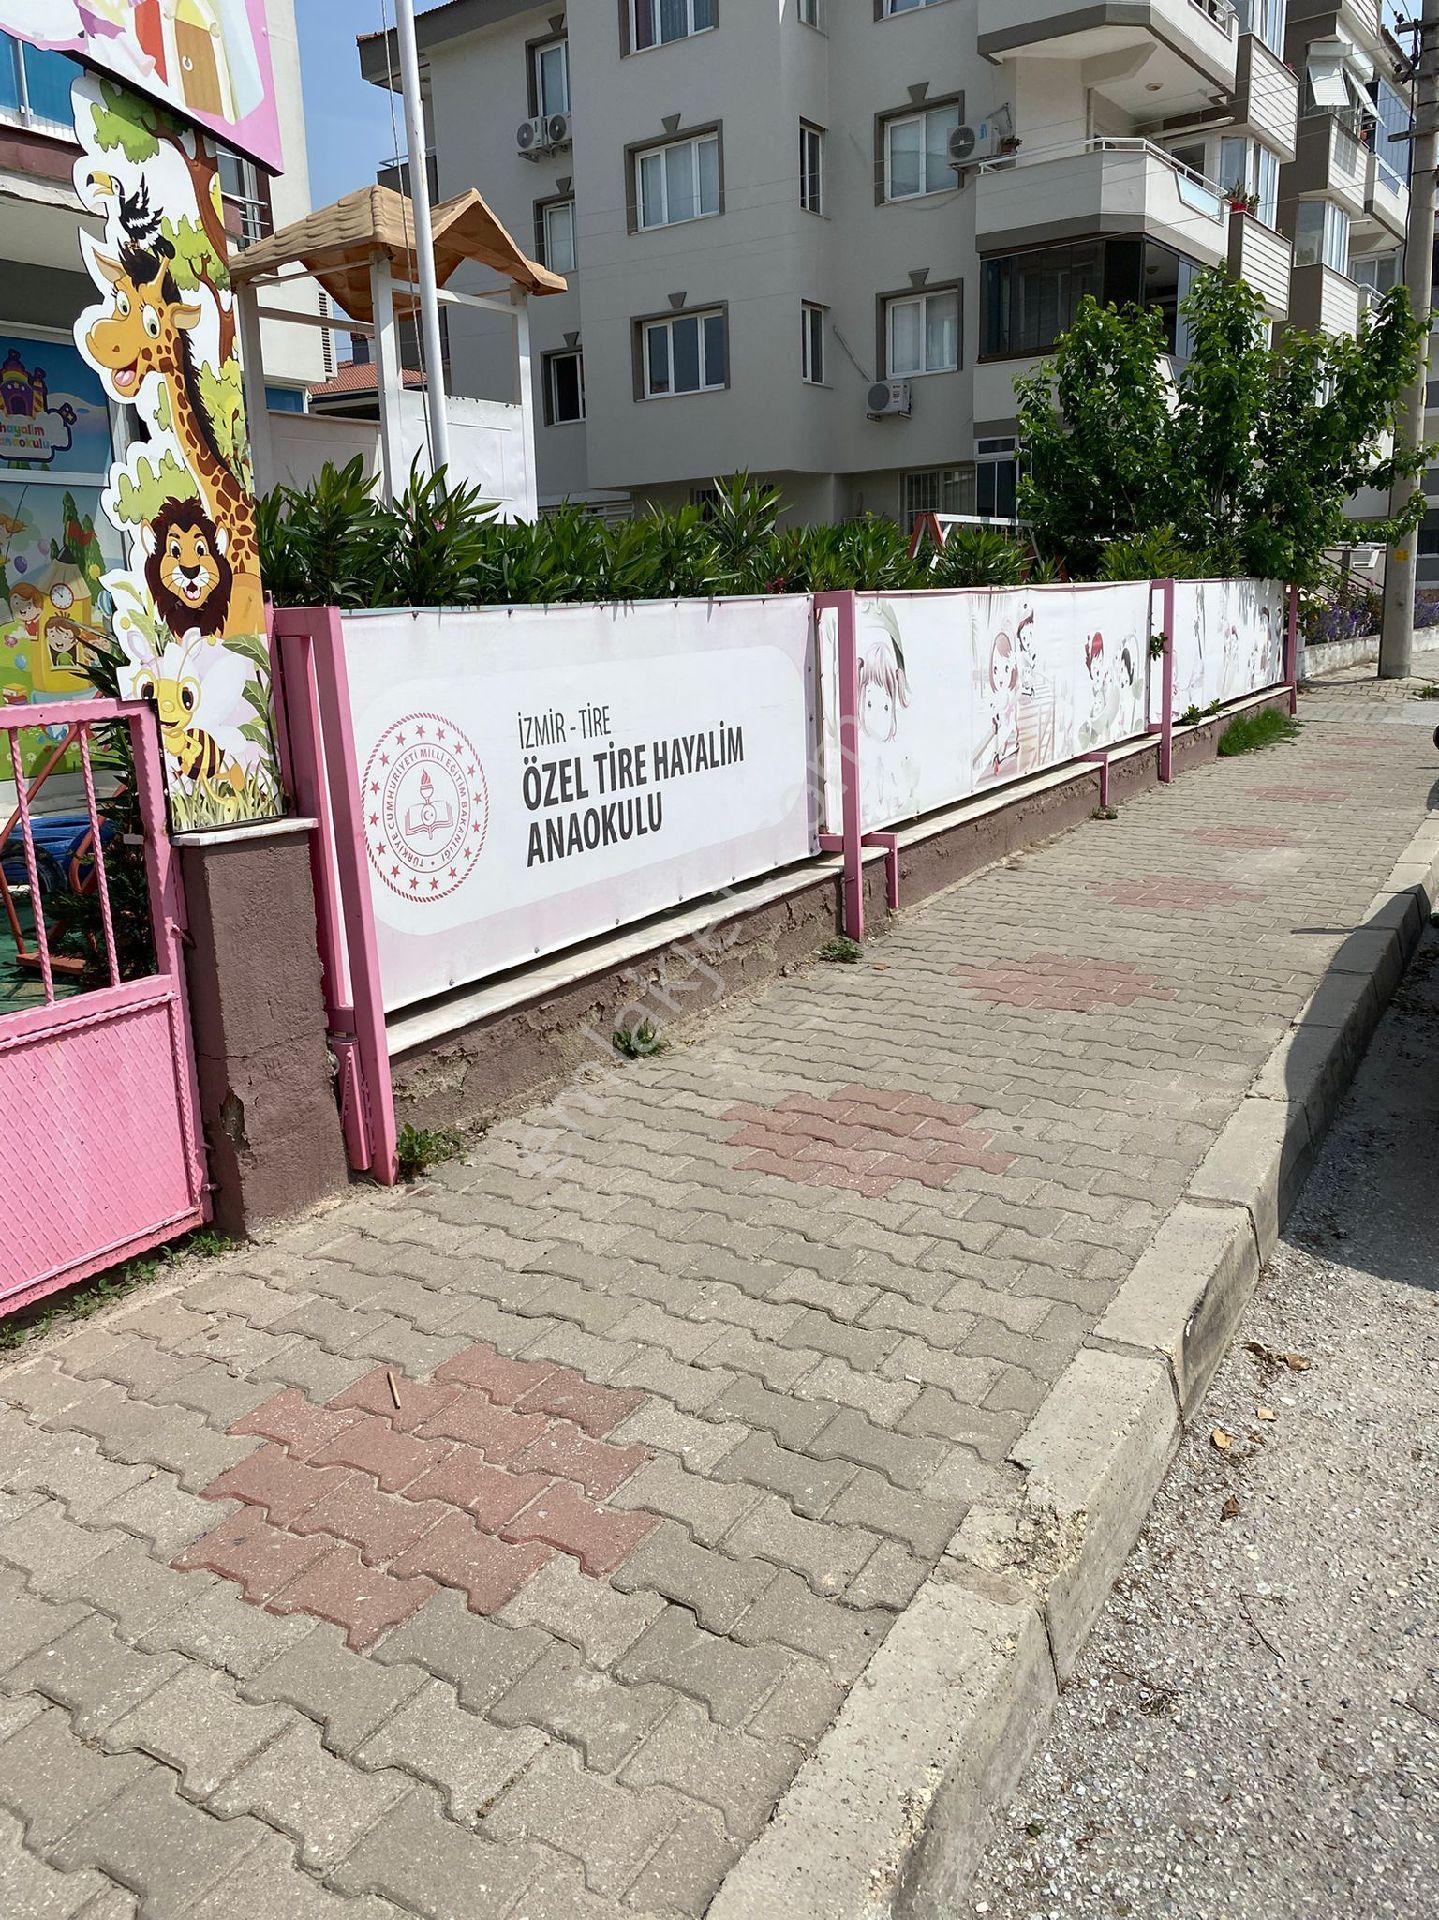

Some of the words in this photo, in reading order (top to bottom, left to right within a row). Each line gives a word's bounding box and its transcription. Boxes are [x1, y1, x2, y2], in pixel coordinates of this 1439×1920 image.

[518, 708, 566, 749] İZMİR
[579, 702, 611, 739] TİRE
[523, 755, 589, 811] ÖZEL
[593, 741, 647, 794] TİRE
[653, 720, 744, 781] HAYALİM
[527, 792, 663, 868] ANAOKULU
